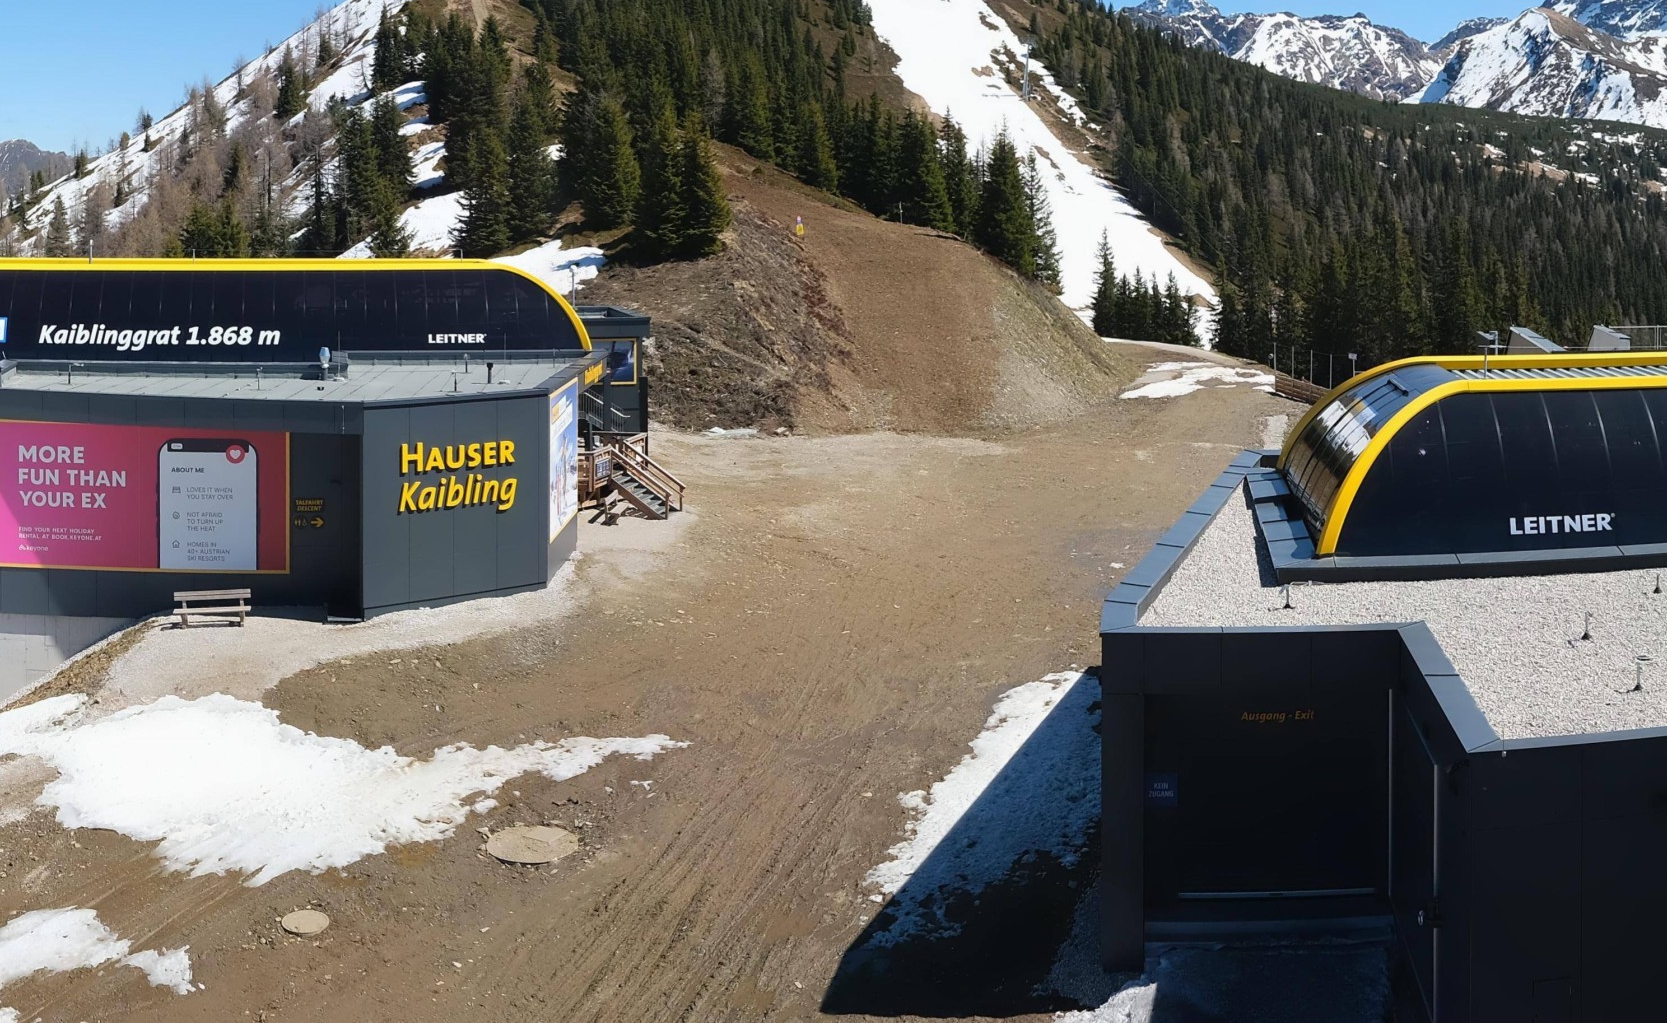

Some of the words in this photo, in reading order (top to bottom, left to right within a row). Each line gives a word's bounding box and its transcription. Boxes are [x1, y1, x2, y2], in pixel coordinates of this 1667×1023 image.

[38, 324, 180, 351] Kaiblinggrat
[186, 326, 253, 345] 1.868
[258, 330, 281, 345] m
[428, 333, 486, 344] LEITNER
[18, 445, 85, 464] MORE
[401, 440, 515, 473] HAUSER
[18, 468, 60, 486] FUN
[66, 469, 126, 488] THAN
[19, 490, 75, 508] YOUR
[81, 492, 107, 509] EX
[399, 474, 518, 512] Kaibling
[1509, 513, 1614, 535] LEITNER
[1241, 711, 1286, 723] Ausgang
[1294, 709, 1315, 720] Exit
[1148, 790, 1175, 798] ZUGANG
[1153, 782, 1169, 790] KEIN
